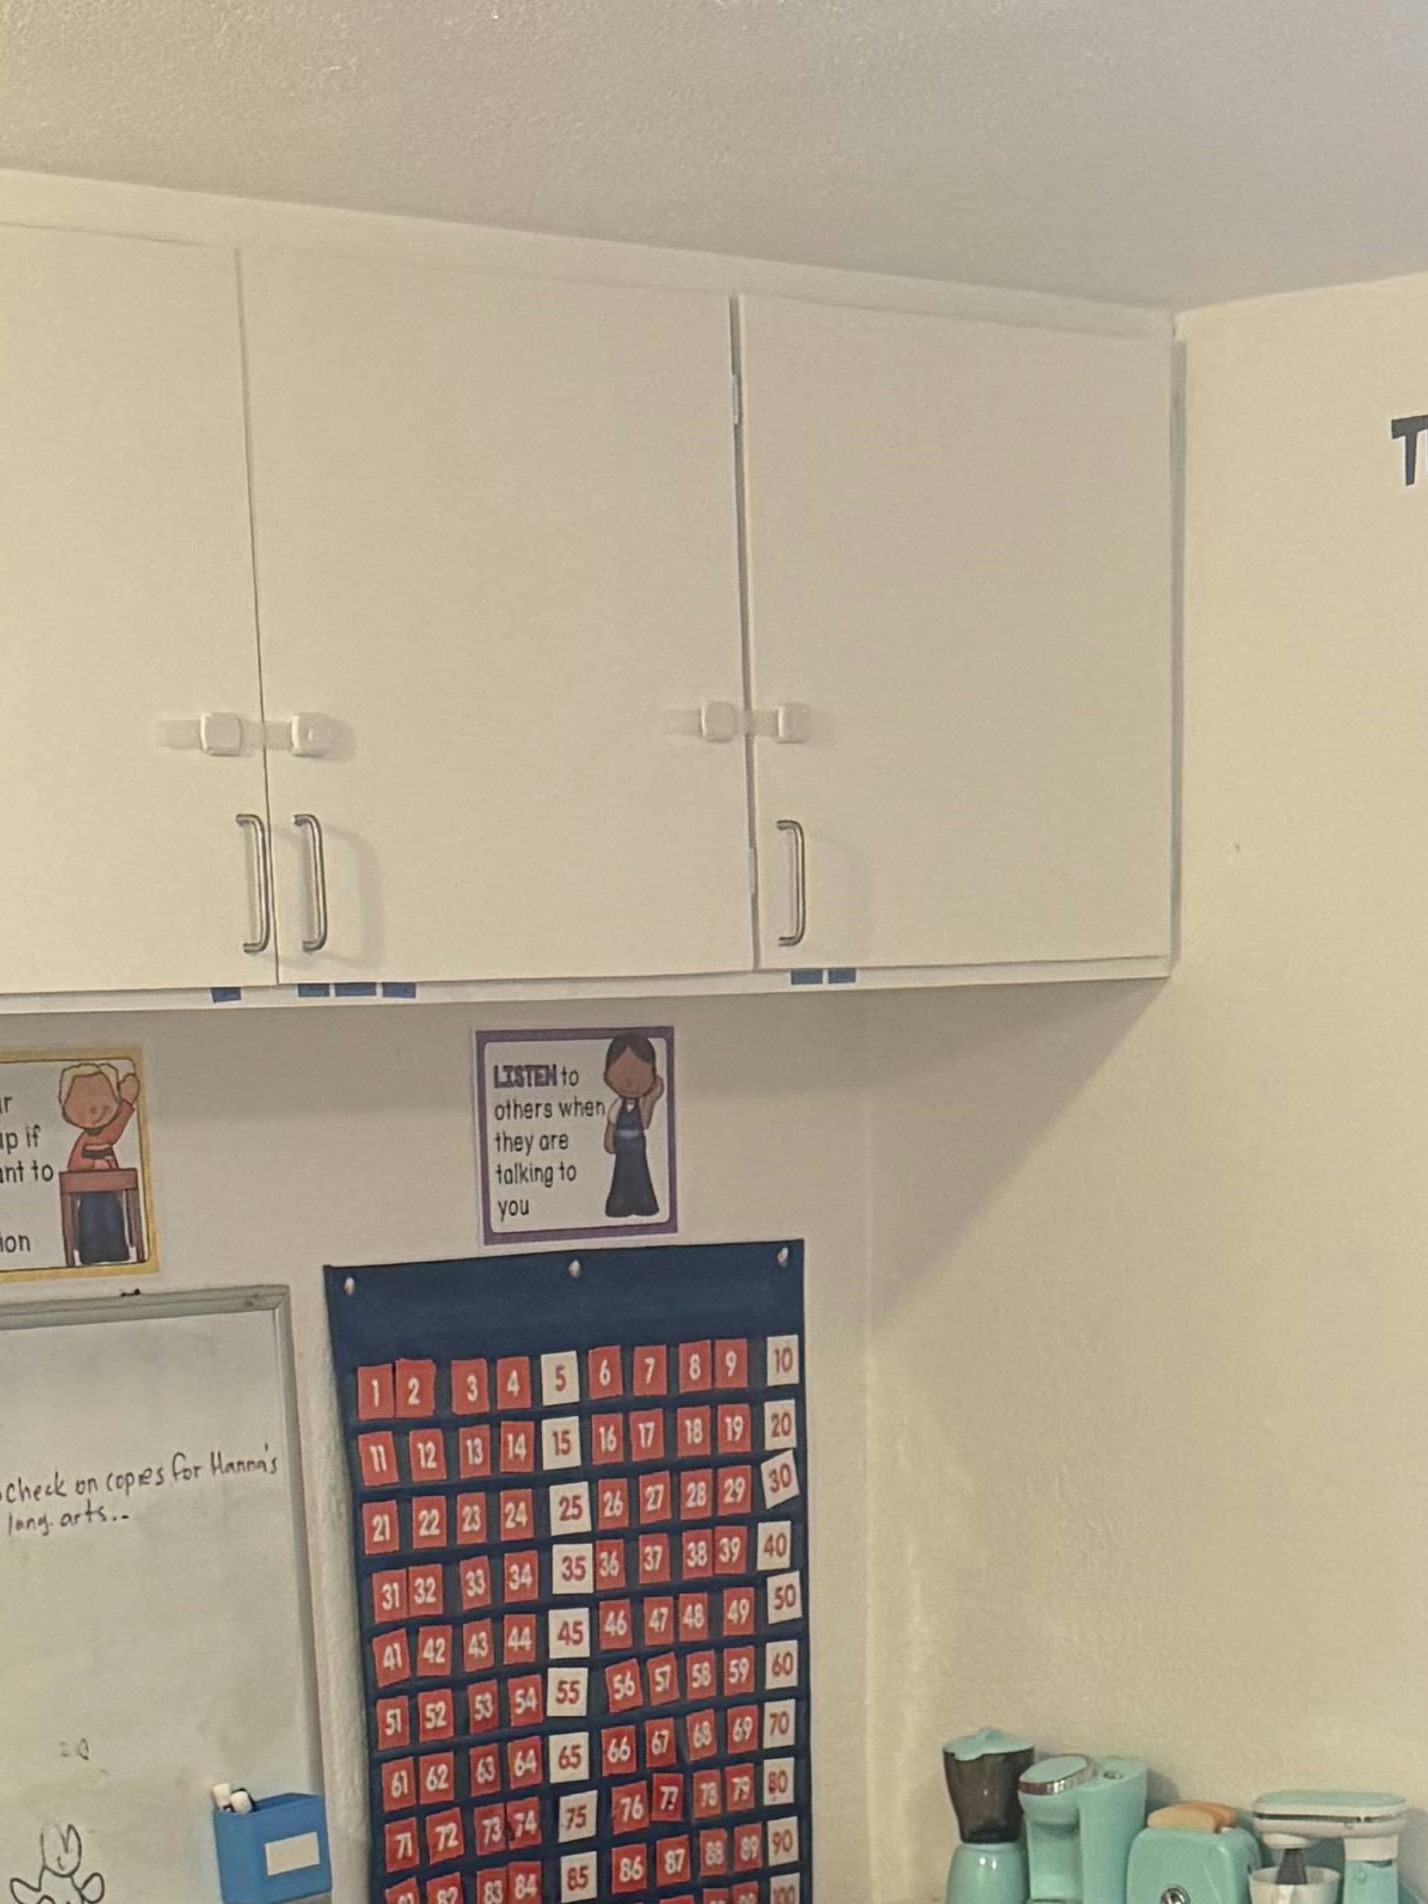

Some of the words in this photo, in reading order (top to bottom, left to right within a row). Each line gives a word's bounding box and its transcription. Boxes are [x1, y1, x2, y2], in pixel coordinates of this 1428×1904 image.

[493, 1064, 557, 1088] LISTEN
[562, 1069, 579, 1086] to
[495, 1099, 553, 1121] others
[559, 1096, 605, 1117] when
[25, 1124, 40, 1148] if
[495, 1131, 534, 1156] they
[539, 1134, 569, 1150] are
[33, 1160, 54, 1181] to
[496, 1163, 553, 1187] talking
[560, 1162, 576, 1181] to
[498, 1199, 529, 1221] you
[372, 1379, 379, 1405] 1
[407, 1378, 419, 1405] 2
[467, 1375, 478, 1401] 3
[507, 1370, 520, 1394] 4
[554, 1366, 566, 1392] 5
[599, 1360, 610, 1385] 6
[644, 1358, 655, 1383] 7
[689, 1354, 701, 1377] 8
[725, 1351, 736, 1375] 9
[774, 1347, 793, 1372] 10
[76, 1478, 98, 1496] on
[172, 1452, 202, 1481] for
[385, 1708, 401, 1735] 51
[424, 1702, 446, 1728] 52
[474, 1693, 492, 1719] 53
[516, 1687, 537, 1713] 54
[556, 1680, 581, 1704] 55
[613, 1673, 635, 1699] 56
[655, 1667, 672, 1693] 57
[691, 1662, 711, 1688] 58
[729, 1658, 749, 1682] 59
[772, 1653, 793, 1676] 60
